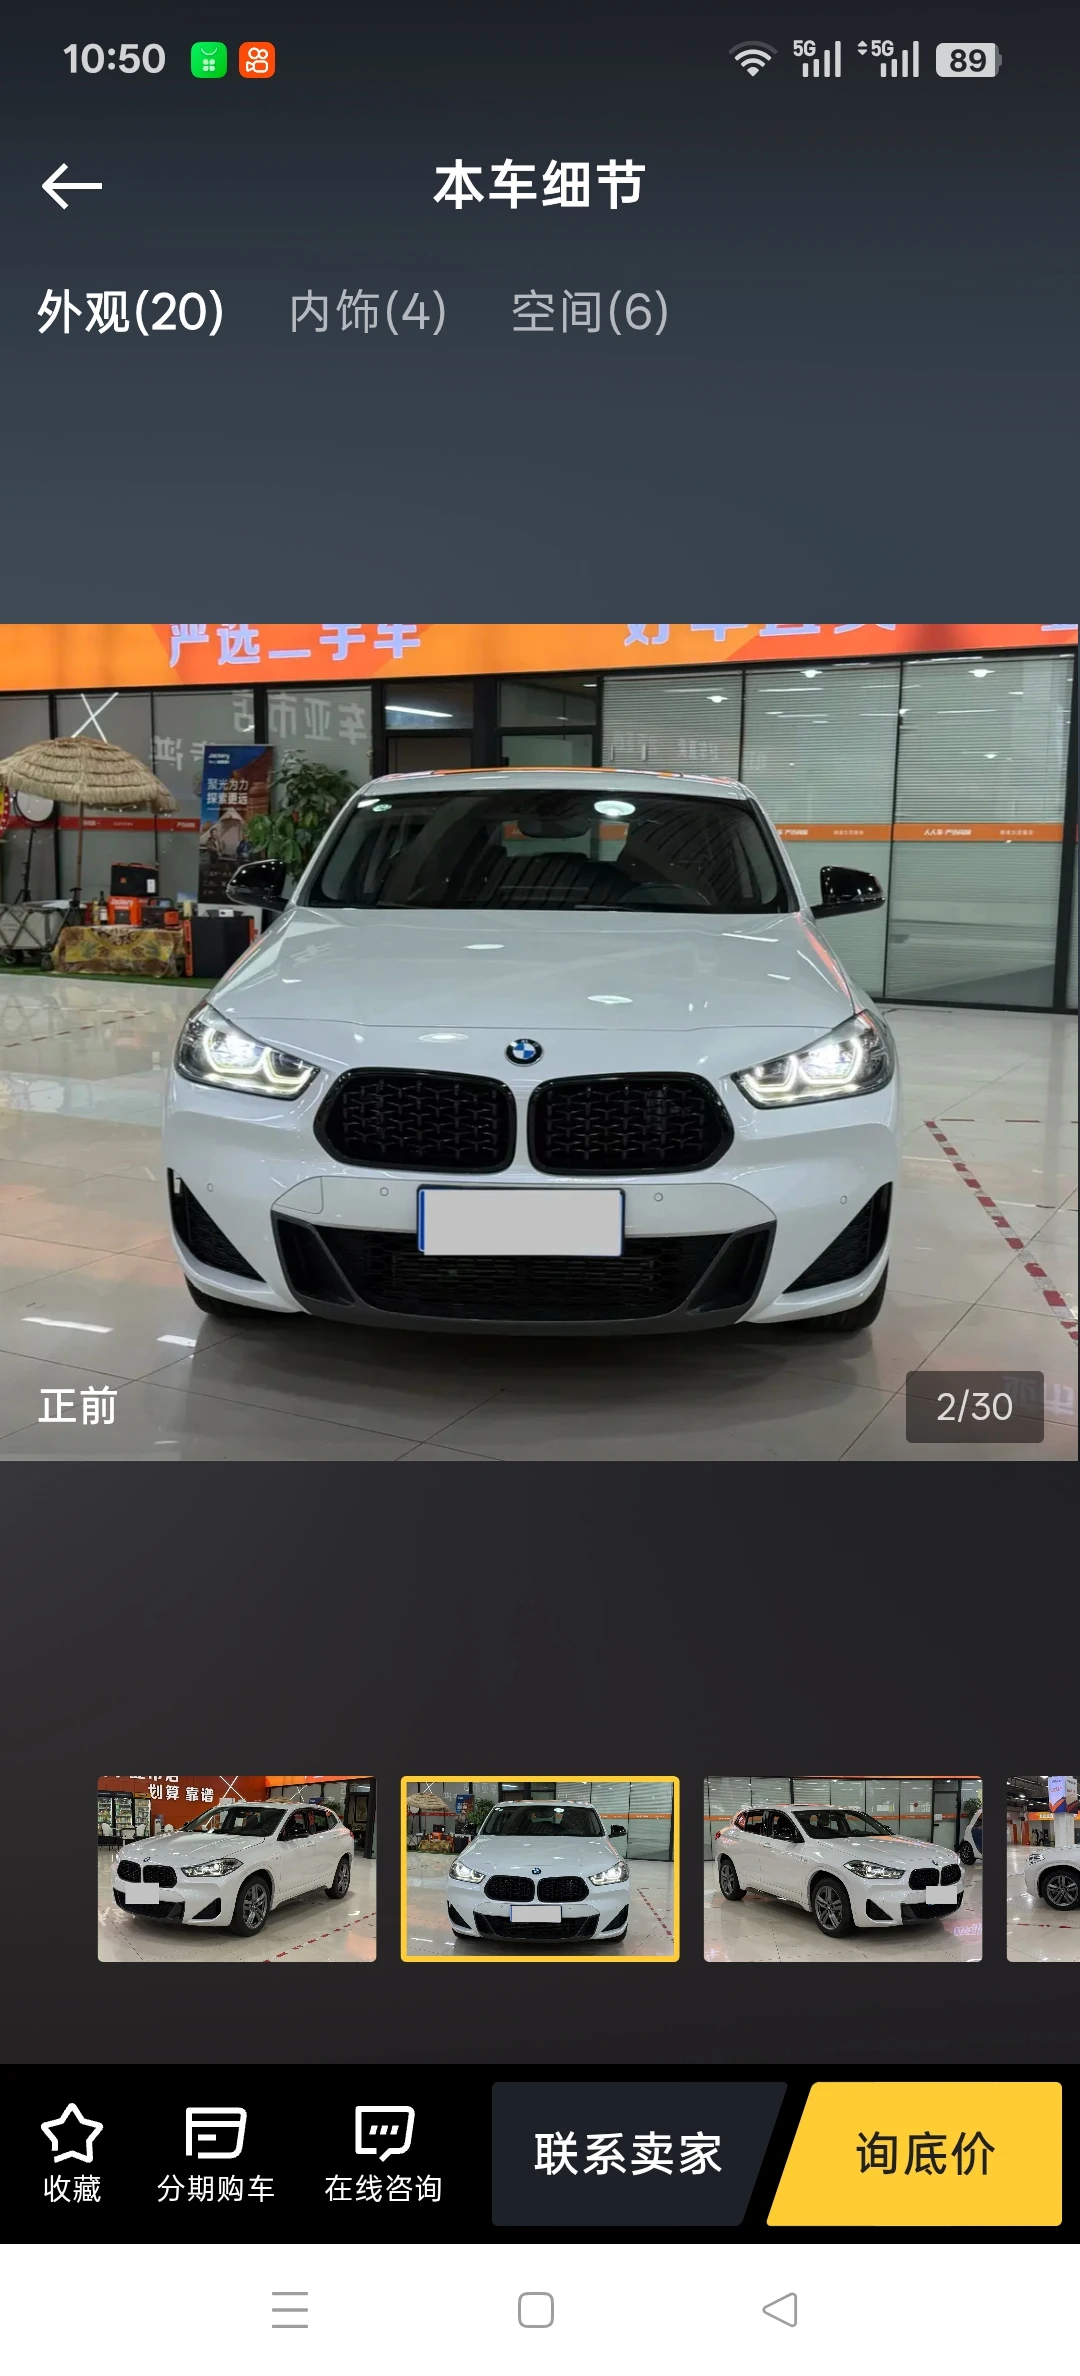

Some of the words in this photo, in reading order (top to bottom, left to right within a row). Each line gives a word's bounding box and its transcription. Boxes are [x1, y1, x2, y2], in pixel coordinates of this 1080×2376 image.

[63, 44, 166, 74] 10:50
[793, 39, 817, 57] 5G
[871, 39, 895, 57] 5G
[949, 48, 987, 73] 89
[432, 158, 646, 210] 本车细节
[36, 288, 224, 337] 外观(20)
[290, 288, 447, 336] 内饰(4)
[511, 288, 669, 336] 空间(6)
[206, 792, 248, 805] 探索更远
[207, 778, 249, 791] 聚光为力
[148, 1783, 180, 1801] 划算
[185, 1786, 214, 1803] 靠谱
[534, 2130, 723, 2176] 联系卖家
[856, 2130, 996, 2176] 询底价
[43, 2174, 102, 2204] 收藏
[157, 2173, 275, 2203] 分期购车
[324, 2173, 442, 2203] 在线咨询
